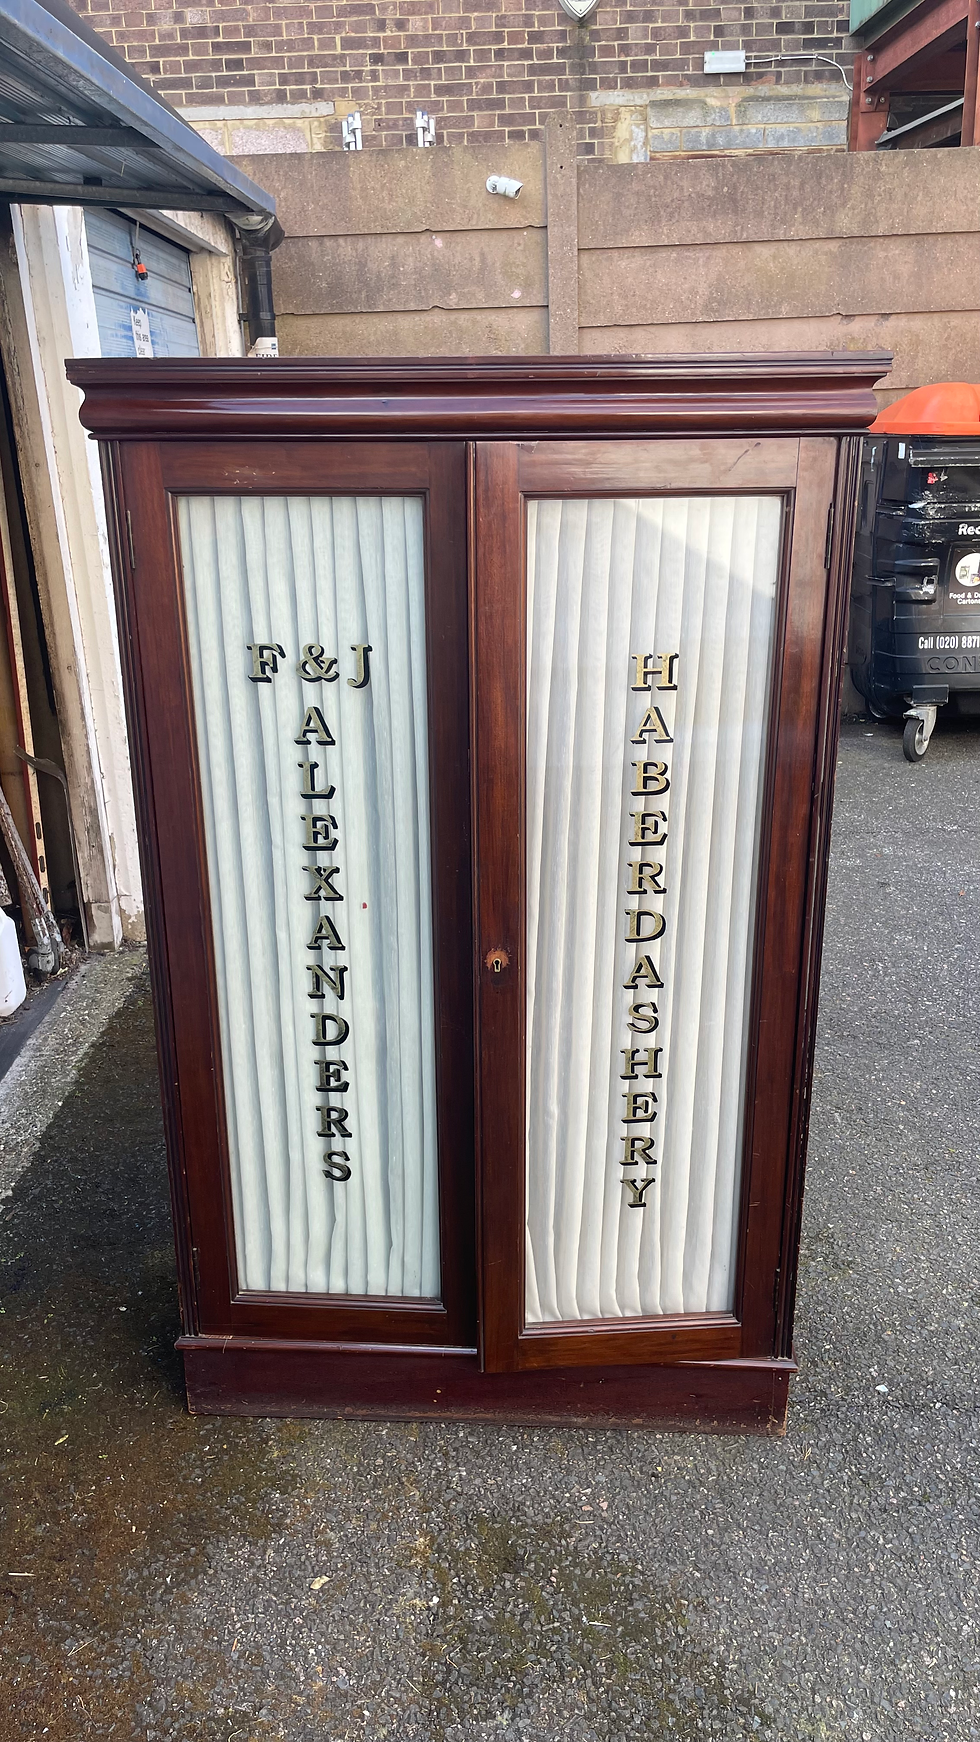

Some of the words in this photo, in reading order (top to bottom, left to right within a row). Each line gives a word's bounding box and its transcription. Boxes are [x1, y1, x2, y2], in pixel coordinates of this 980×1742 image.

[949, 592, 966, 600] Food
[918, 636, 934, 649] Call
[936, 635, 959, 649] (020)
[961, 635, 980, 649] 8871
[927, 655, 980, 674] CON
[619, 652, 680, 1208] HABERDASHERY
[294, 705, 353, 1182] ALEXANDERS
